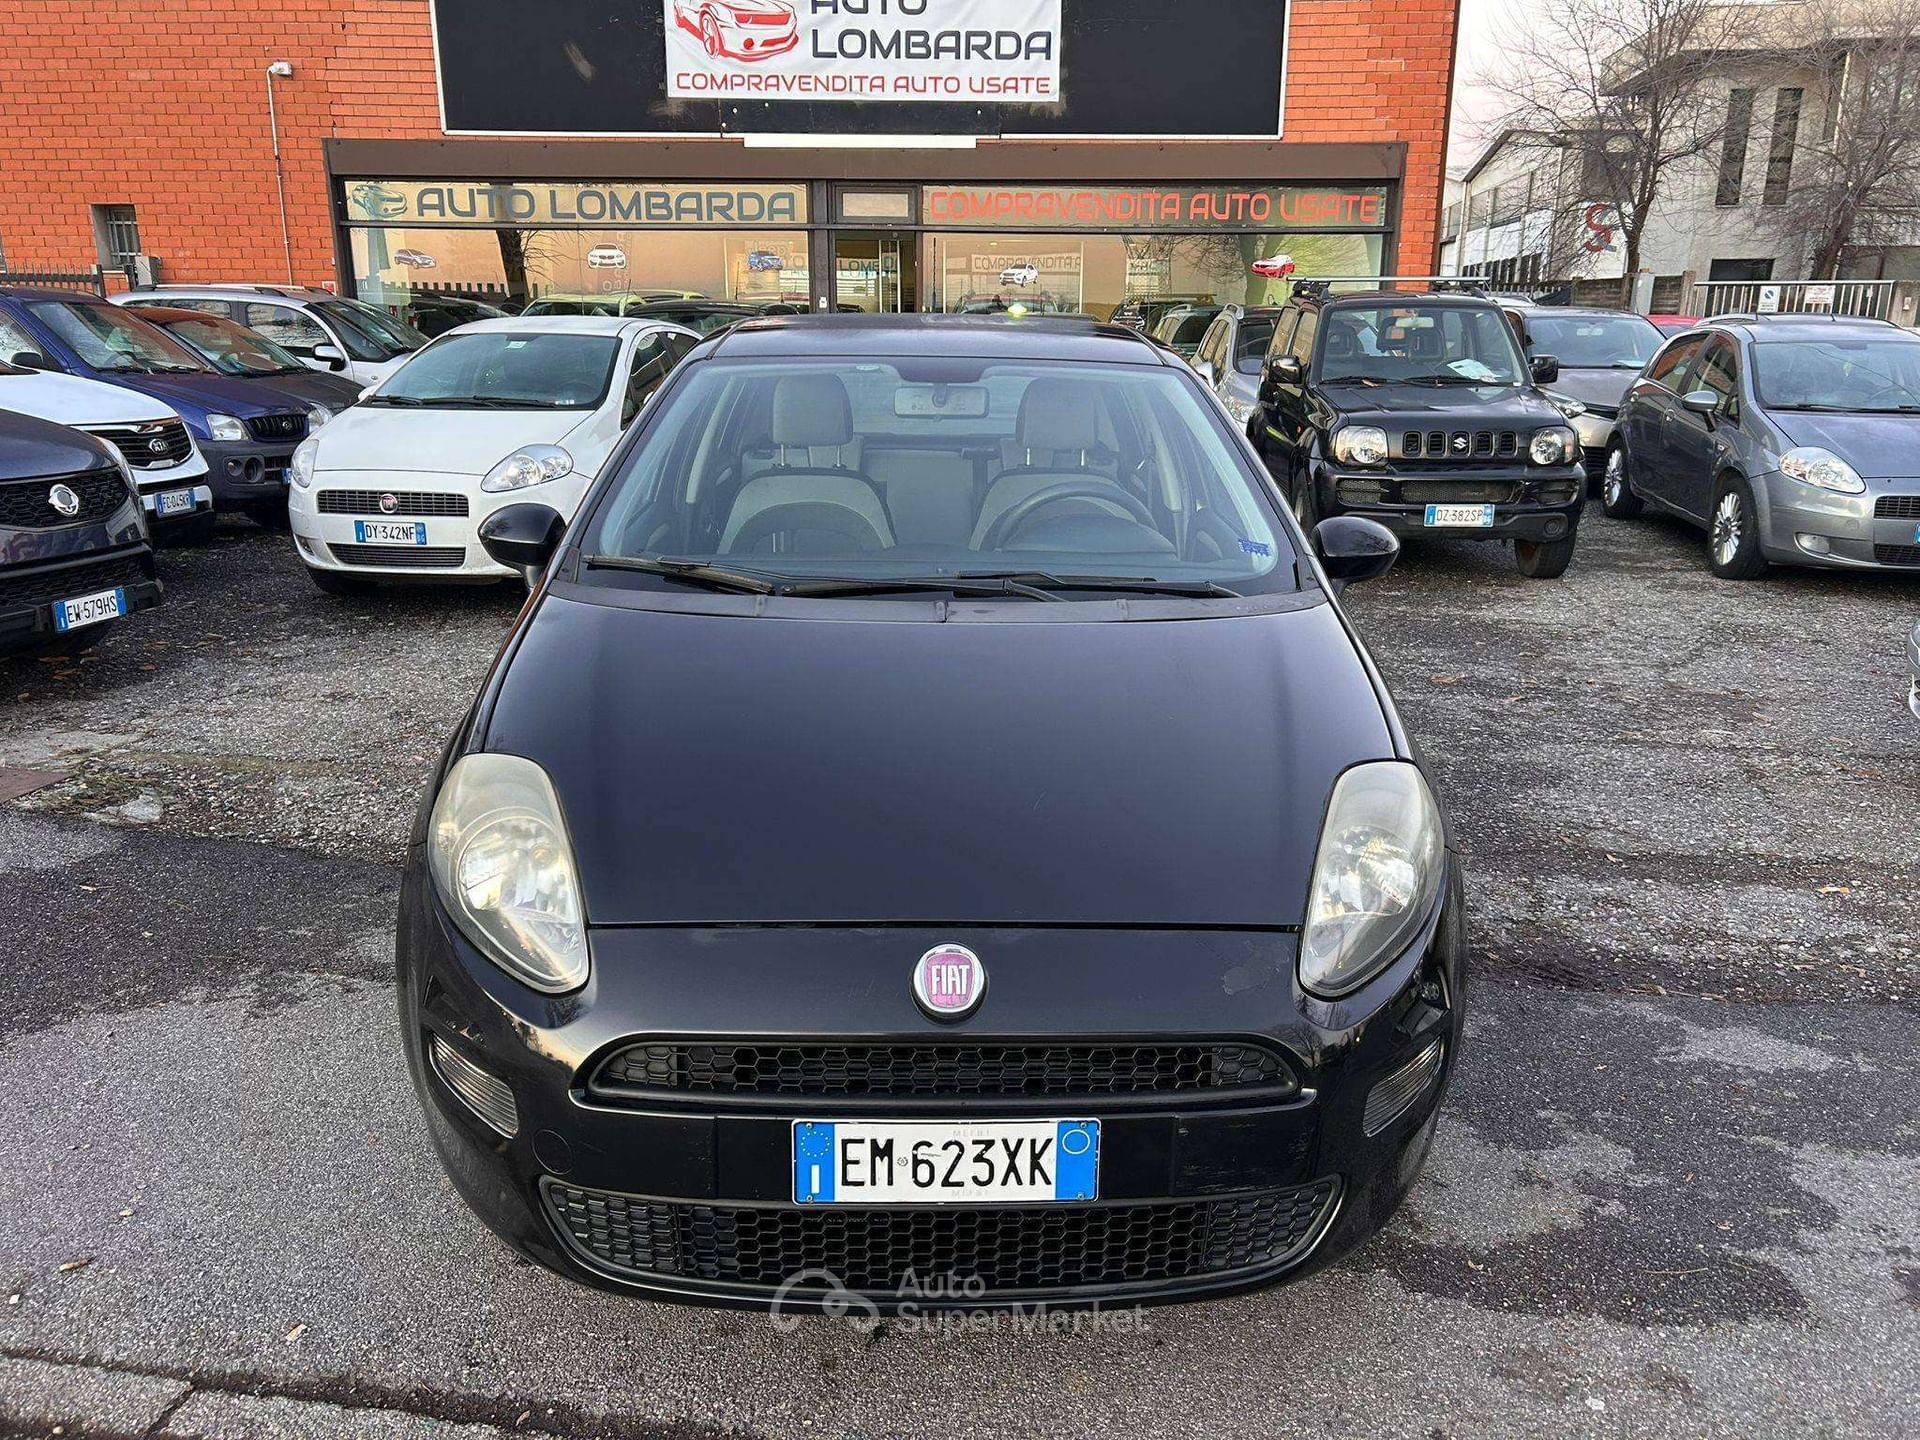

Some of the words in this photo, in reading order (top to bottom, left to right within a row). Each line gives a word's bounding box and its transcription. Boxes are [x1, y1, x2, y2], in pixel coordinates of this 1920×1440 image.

[811, 28, 1052, 60] LOMBARDA
[676, 72, 885, 93] COMPRAVENDITA
[894, 75, 961, 94] AUTO
[969, 76, 1050, 94] USATE
[416, 187, 536, 219] AUTO
[549, 189, 796, 222] LOMBARDA
[931, 190, 1182, 221] COMPRAVENDITA
[1189, 192, 1271, 221] AUTO
[1279, 193, 1380, 223] USATE
[83, 595, 117, 619] 579HS
[931, 964, 970, 995] FIAT
